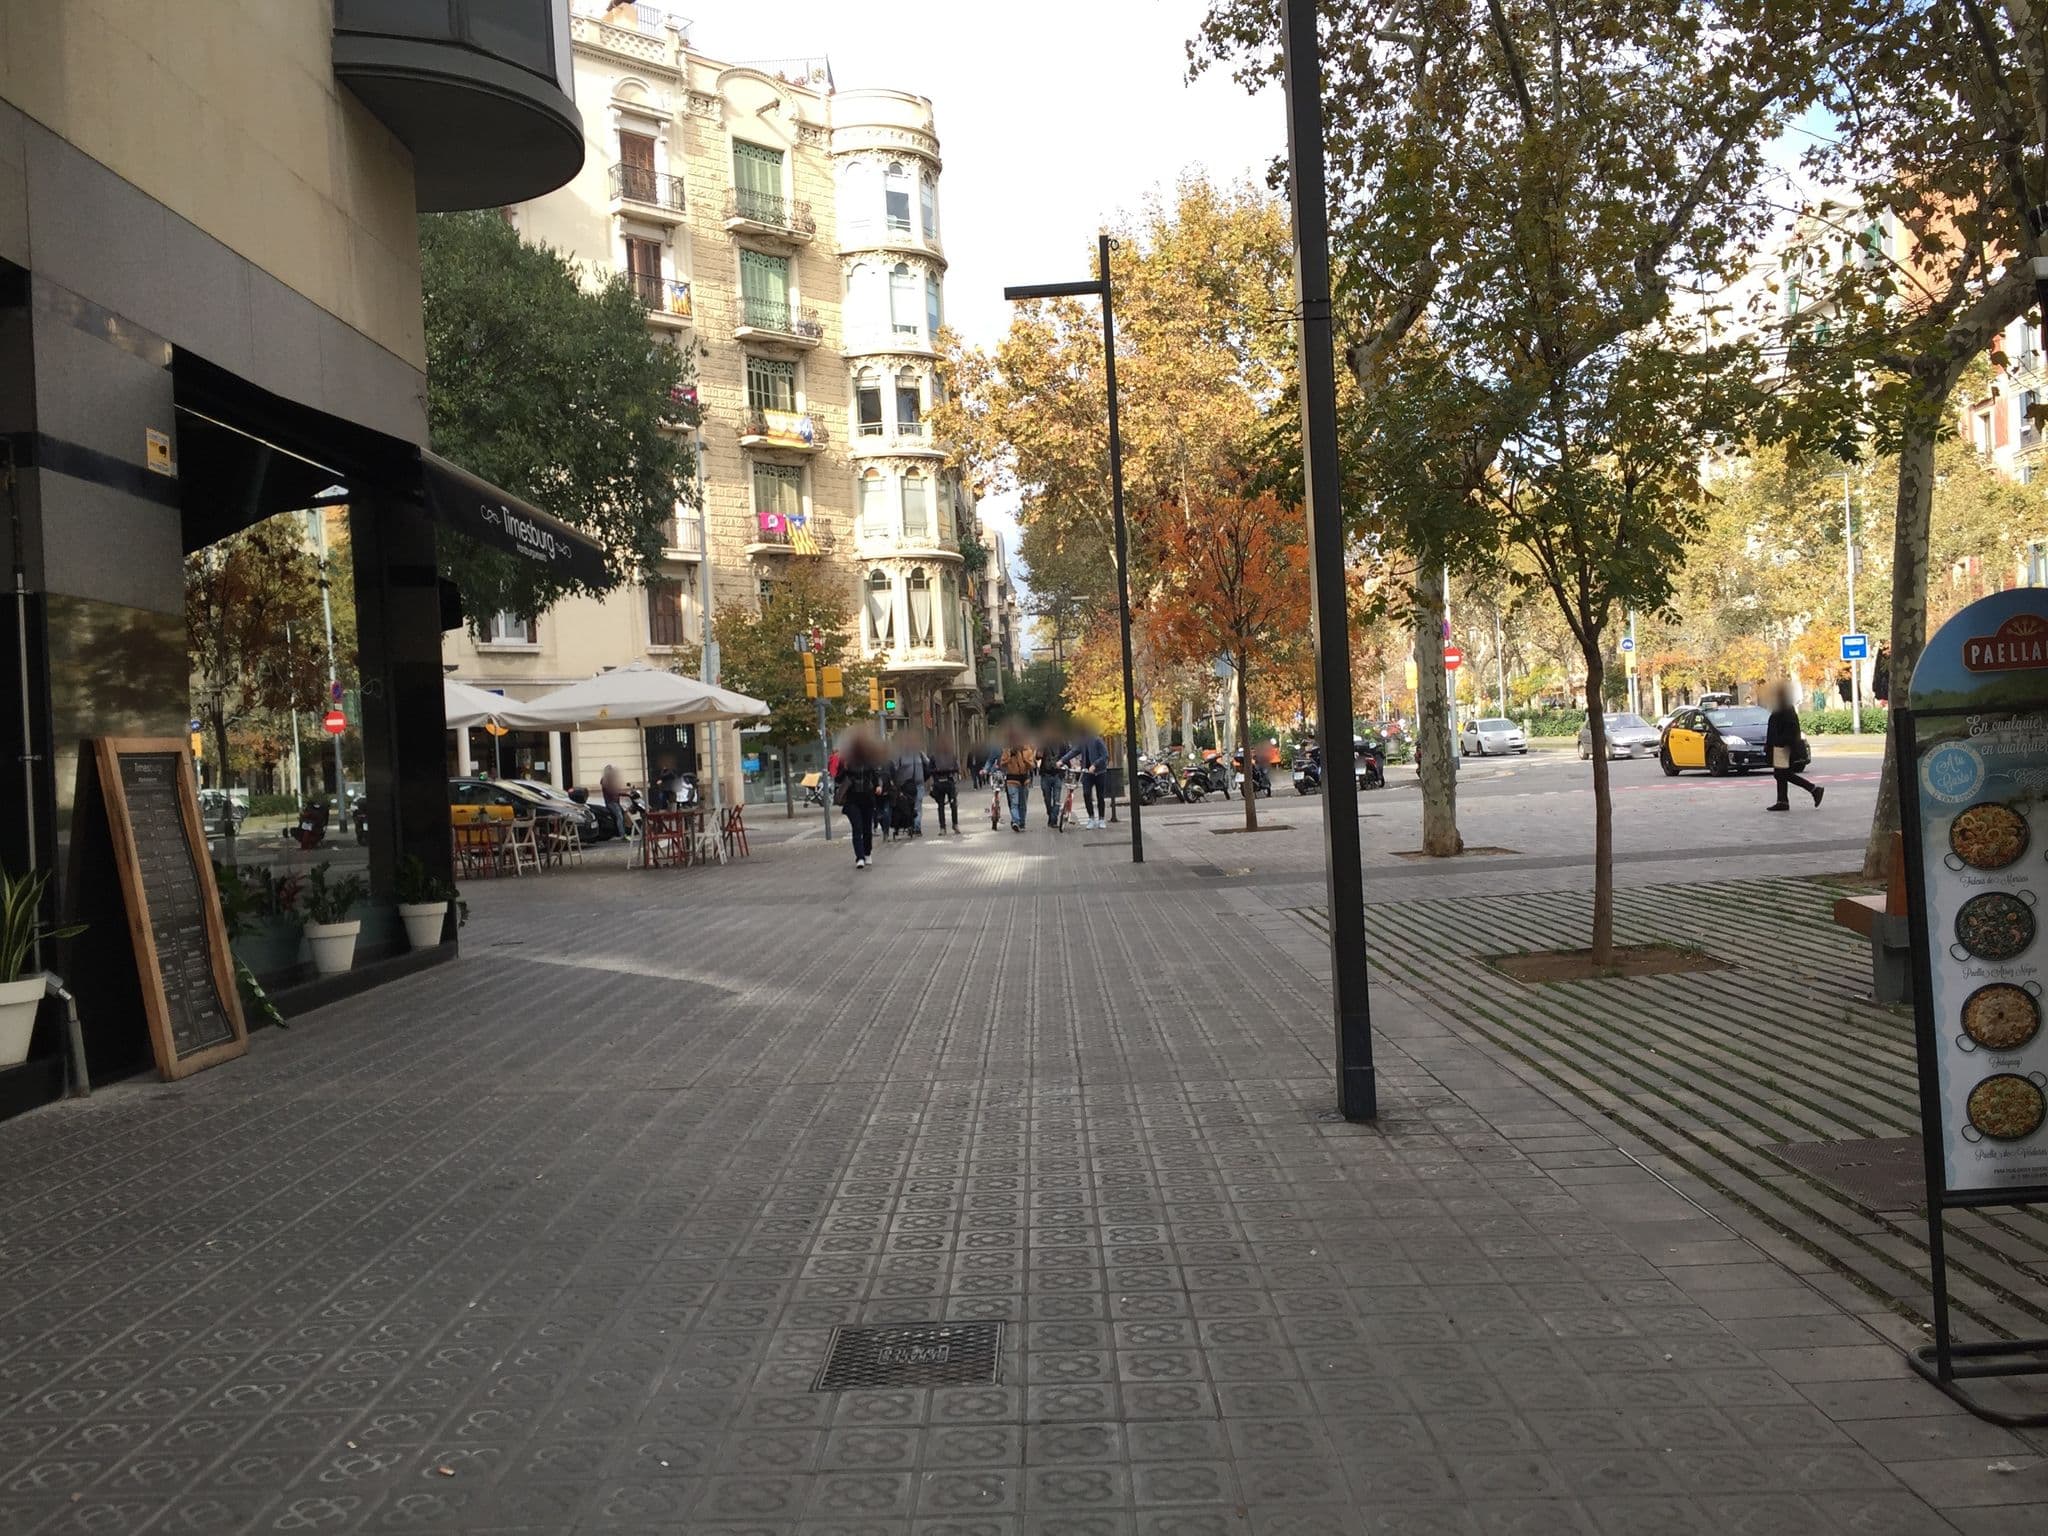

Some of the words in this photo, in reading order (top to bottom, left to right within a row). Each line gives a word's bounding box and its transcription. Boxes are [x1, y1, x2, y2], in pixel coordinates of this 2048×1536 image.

[501, 505, 556, 559] Timesburg
[1971, 641, 2048, 664] PAELLA
[1966, 714, 1992, 737] En
[1981, 744, 1994, 755] en
